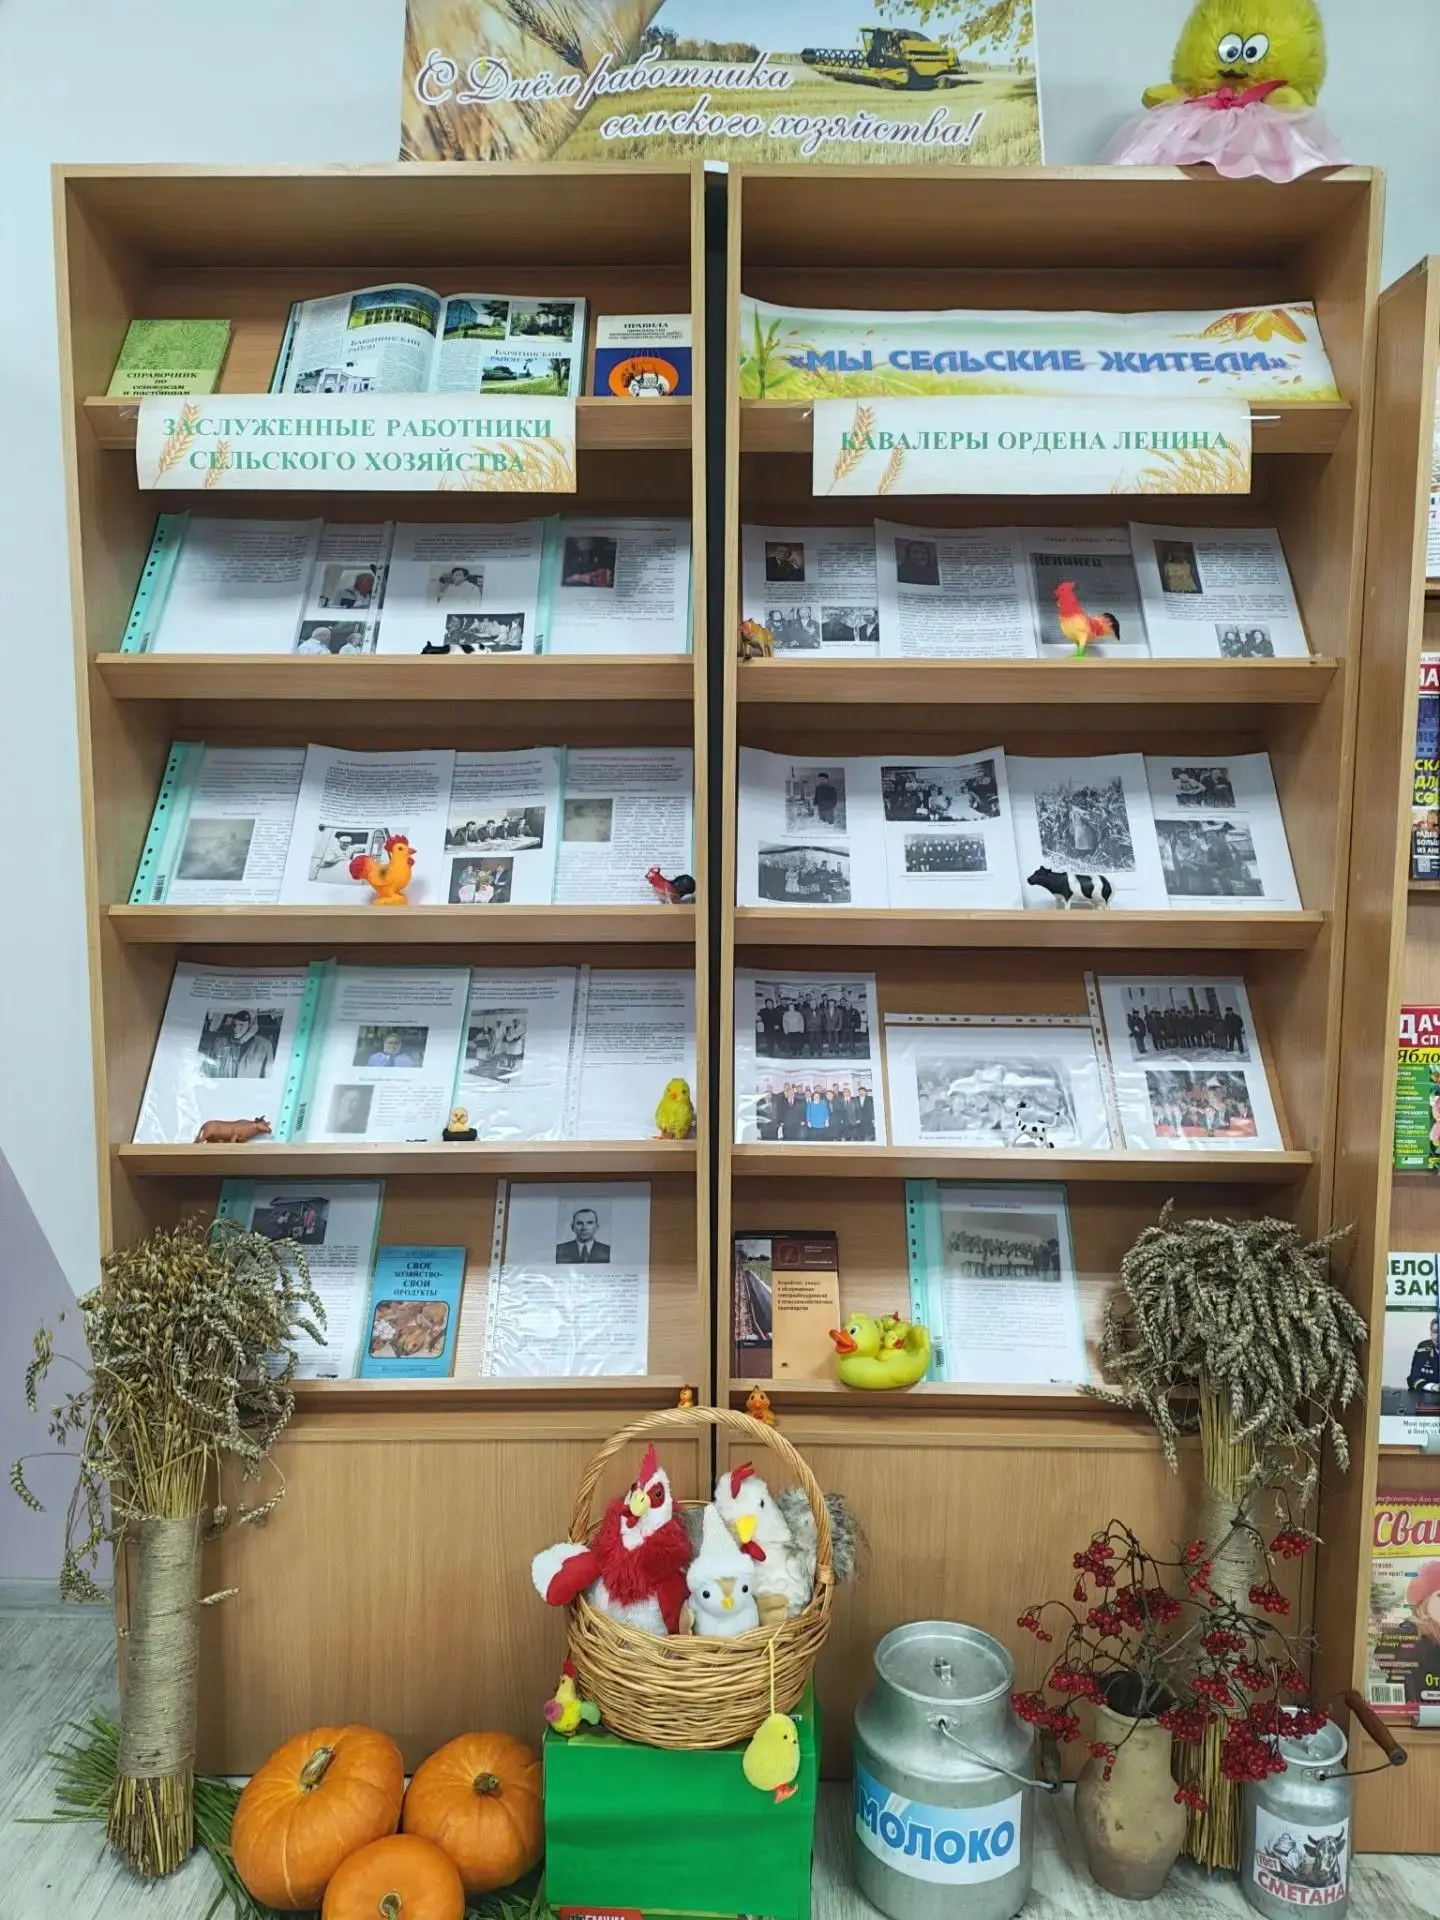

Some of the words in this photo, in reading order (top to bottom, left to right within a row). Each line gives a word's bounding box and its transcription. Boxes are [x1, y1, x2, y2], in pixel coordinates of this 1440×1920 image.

[417, 50, 456, 103] С
[459, 57, 580, 102] Днём
[576, 46, 791, 108] работника
[603, 95, 760, 137] сельского
[770, 107, 984, 154] хозяйства!
[789, 348, 873, 374] «МЫ
[888, 348, 1085, 375] СЕЛЬСКИЕ
[1100, 349, 1288, 375] ЖИТЕЛИ»
[162, 418, 376, 437] ЗАСЛУЖЕННЫЕ
[386, 418, 552, 438] РАБОТНИКИ
[840, 431, 990, 452] КАВАЛЕРЫ
[997, 431, 1106, 453] ОРДЕНА
[1113, 431, 1229, 451] ЛЕНИНА
[189, 450, 356, 471] СЕЛЬСКОГО
[363, 447, 527, 473] ХОЗЯЙСТВА
[1386, 1259, 1434, 1277] ЕЛО
[860, 1788, 1015, 1865] МОЛОКО
[1257, 1871, 1345, 1905] СМЕТАНА
